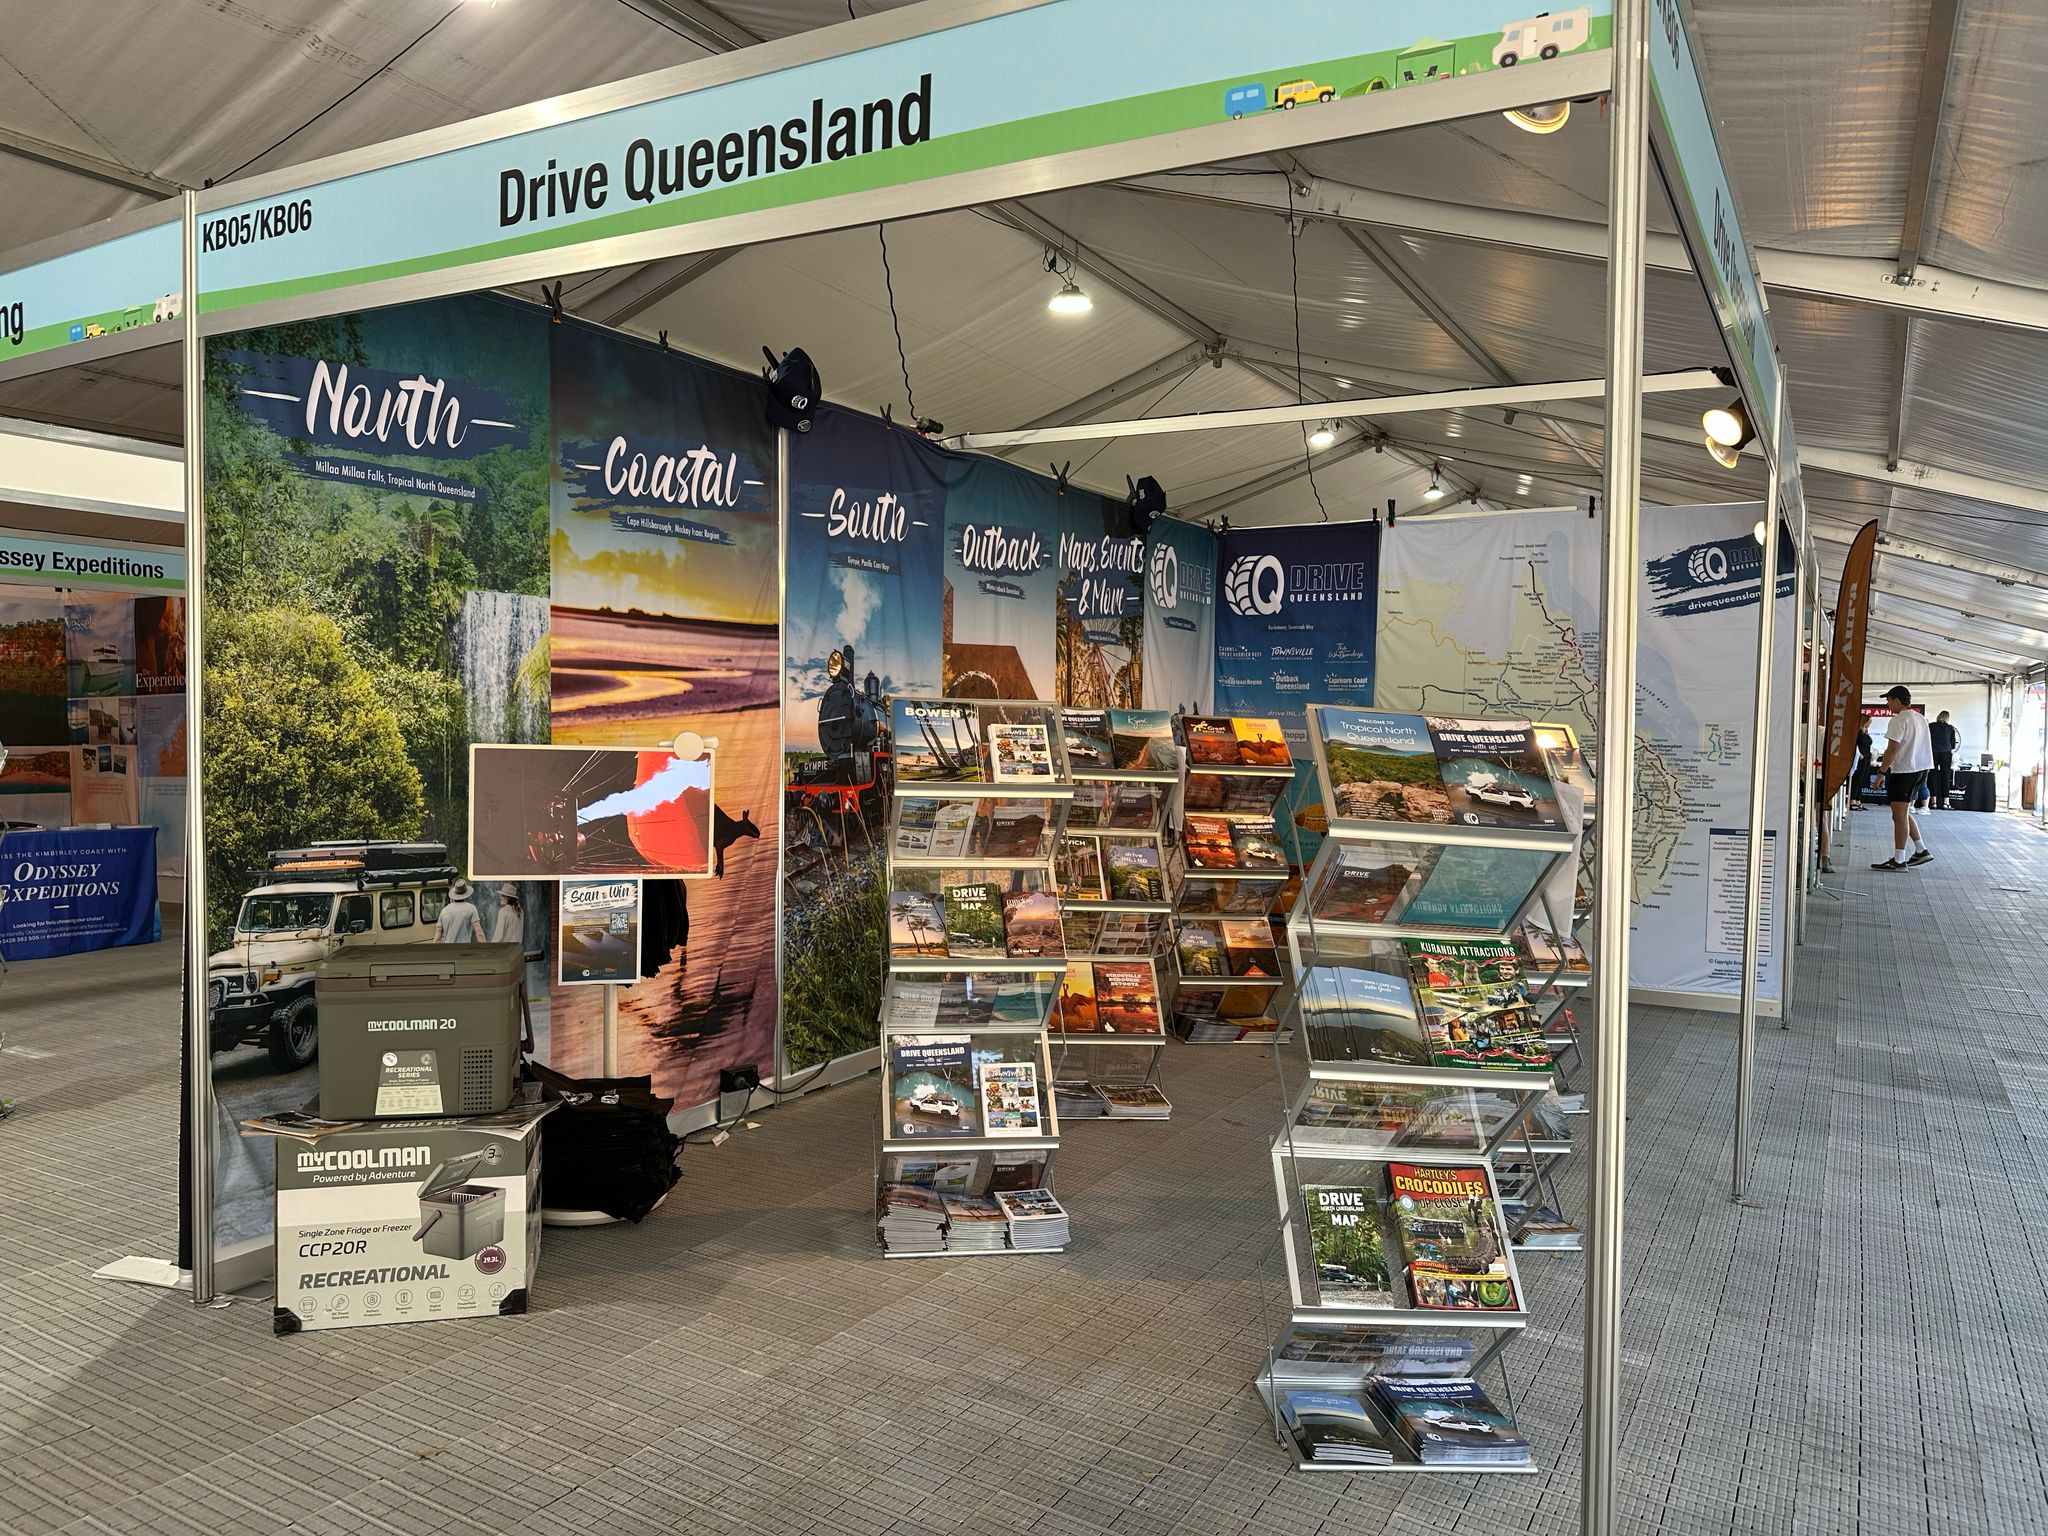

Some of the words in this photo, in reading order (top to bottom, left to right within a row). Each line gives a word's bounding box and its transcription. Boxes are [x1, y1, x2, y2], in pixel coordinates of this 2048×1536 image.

[500, 159, 608, 227] Drive
[625, 73, 932, 205] Queensland
[202, 199, 313, 253] KB05/KB06
[305, 359, 470, 451] North
[315, 460, 340, 475] Millaa
[341, 464, 366, 480] Millaa
[367, 469, 387, 485] Falls,
[388, 473, 414, 488] Tropical
[416, 478, 436, 492] North
[437, 482, 476, 499] Queensland
[605, 436, 741, 508] Coastal
[827, 488, 909, 543] South
[627, 515, 640, 527] Cape
[704, 528, 720, 541] Region
[963, 524, 1043, 571] Outback
[1059, 532, 1099, 578] Maps,
[1101, 534, 1145, 574] Events
[52, 551, 164, 579] Expeditions
[1290, 563, 1364, 591] DRIVE
[1079, 578, 1090, 615] &
[1092, 578, 1125, 615] More
[1289, 592, 1363, 603] QUEENSLAND
[1270, 646, 1315, 656] TOWNSVILLE
[1275, 682, 1310, 690] Queensland
[904, 707, 960, 718] BOWEN
[1340, 721, 1383, 733] Tropical
[1385, 727, 1417, 736] North
[1346, 732, 1415, 745] Queensland
[1439, 733, 1467, 742] DRIVE
[1467, 733, 1526, 743] QUEENSLAND
[571, 890, 600, 903] Scan
[609, 885, 629, 898] Win
[952, 888, 987, 898] DRIVE
[961, 902, 982, 910] MAP
[13, 921, 37, 929] Looking
[1420, 941, 1458, 955] KURANDA
[1460, 946, 1516, 957] ATTRACTIONS
[439, 1018, 457, 1030] 20
[901, 1049, 922, 1057] DRIVE
[922, 1047, 965, 1057] QUEENSLAND
[312, 1172, 354, 1184] Powered
[355, 1172, 368, 1182] by
[369, 1169, 416, 1180] Adventure
[1414, 1167, 1458, 1180] HARTLEY'S
[1395, 1175, 1485, 1196] CROCODILES
[1318, 1192, 1364, 1206] DRIVE
[1419, 1198, 1431, 1208] UP
[1331, 1214, 1359, 1227] MAP
[298, 1228, 323, 1239] Single
[324, 1227, 345, 1237] Zone
[345, 1225, 372, 1236] Fridge
[382, 1223, 412, 1233] Freezer
[299, 1240, 368, 1258] CCP20R
[299, 1263, 451, 1290] RECREATIONAL
[1416, 1384, 1473, 1393] QUEENSLAND
